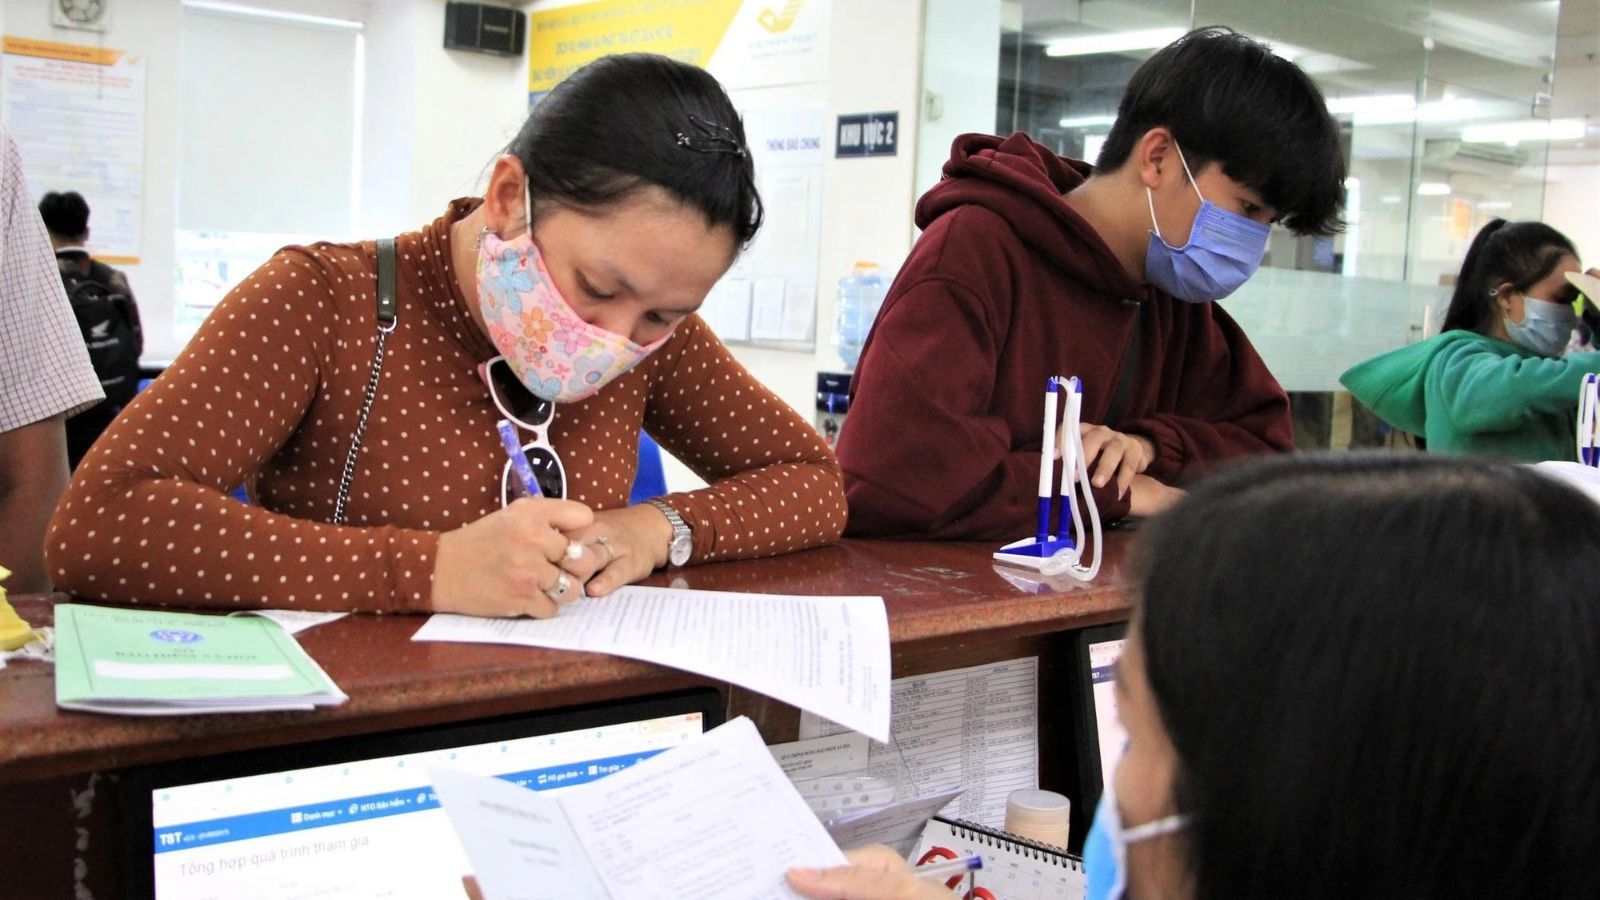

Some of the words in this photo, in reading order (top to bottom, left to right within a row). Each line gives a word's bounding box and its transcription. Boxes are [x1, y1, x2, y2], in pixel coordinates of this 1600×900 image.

[840, 123, 861, 147] KHU
[885, 120, 895, 146] 2
[159, 831, 183, 847] TST
[179, 860, 215, 877] Tổng
[313, 837, 347, 854] tham
[350, 834, 370, 851] gia
